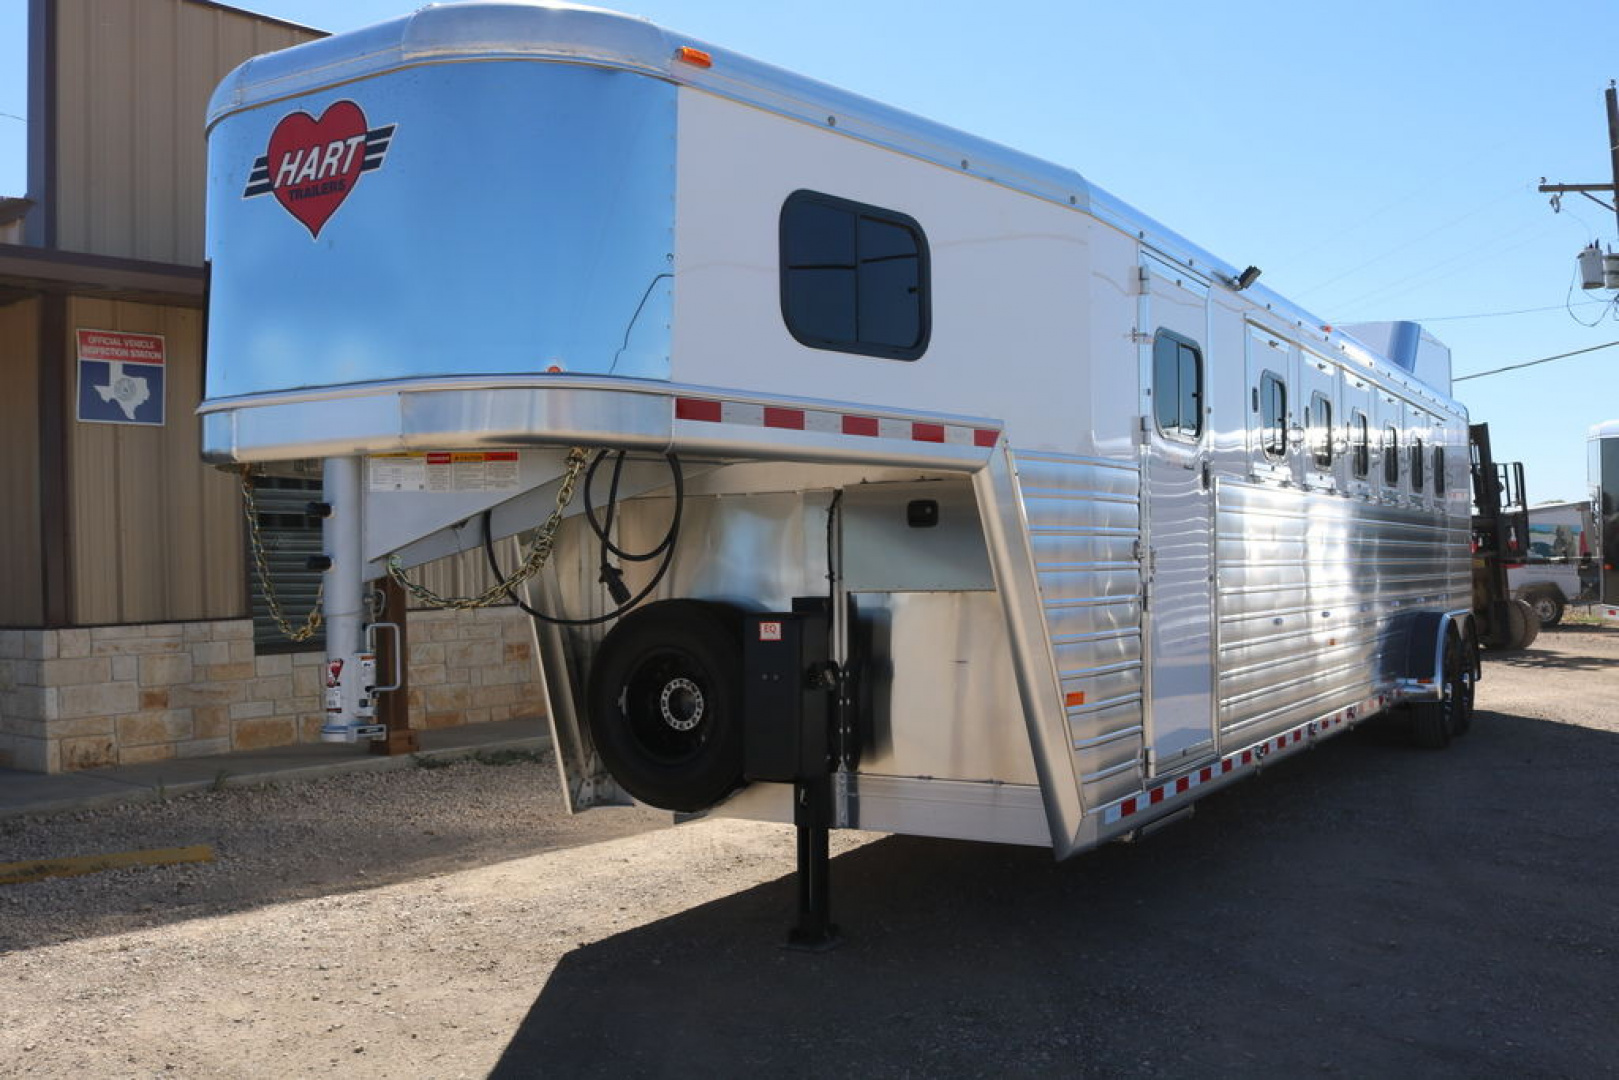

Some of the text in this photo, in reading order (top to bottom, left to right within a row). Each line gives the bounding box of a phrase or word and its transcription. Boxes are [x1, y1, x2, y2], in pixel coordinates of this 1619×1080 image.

[274, 135, 367, 188] HART
[289, 179, 346, 201] TRAILERS
[88, 336, 155, 349] OFFICIAL VEHICLE
[81, 345, 162, 359] INSPECTION STATION
